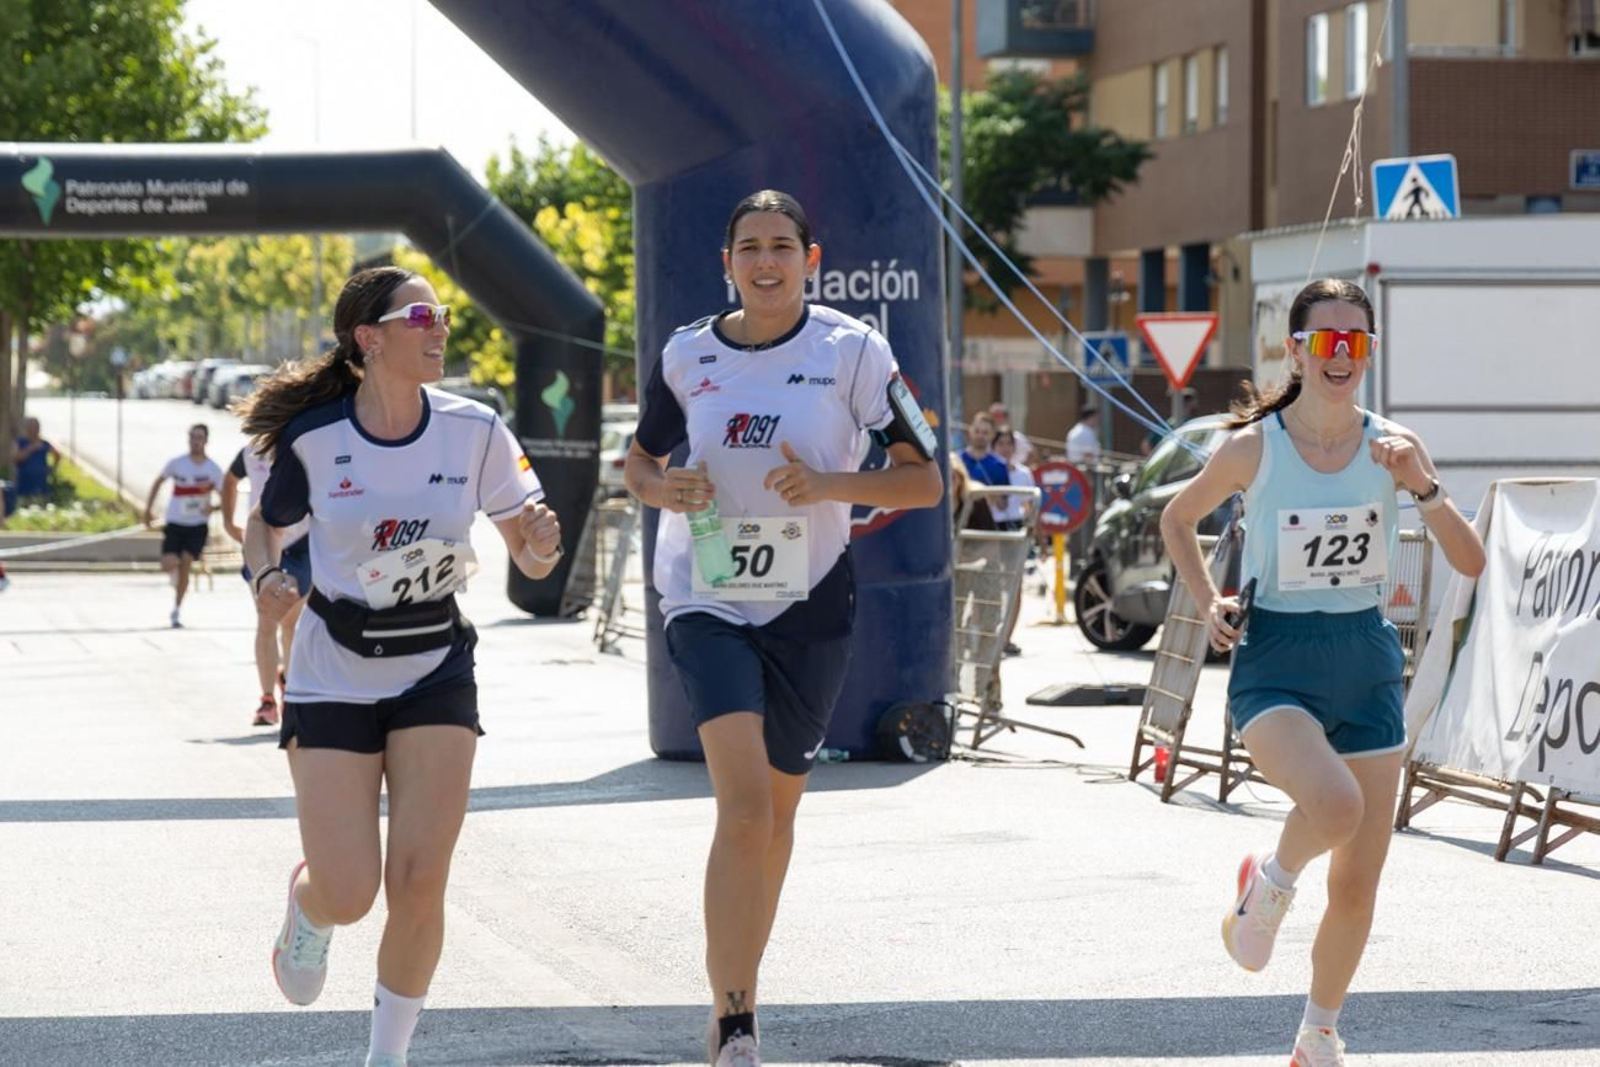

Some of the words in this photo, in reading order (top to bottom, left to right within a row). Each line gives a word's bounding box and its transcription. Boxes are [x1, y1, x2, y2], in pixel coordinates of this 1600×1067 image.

[65, 179, 144, 196] Patronato
[146, 179, 224, 197] Municipal
[226, 179, 248, 196] de
[65, 197, 140, 215] Deportes
[142, 197, 164, 213] de
[167, 196, 207, 213] Jaén
[731, 544, 775, 578] 50
[1303, 532, 1371, 568] 123
[392, 554, 455, 607] 212
[1516, 531, 1600, 620] Patron
